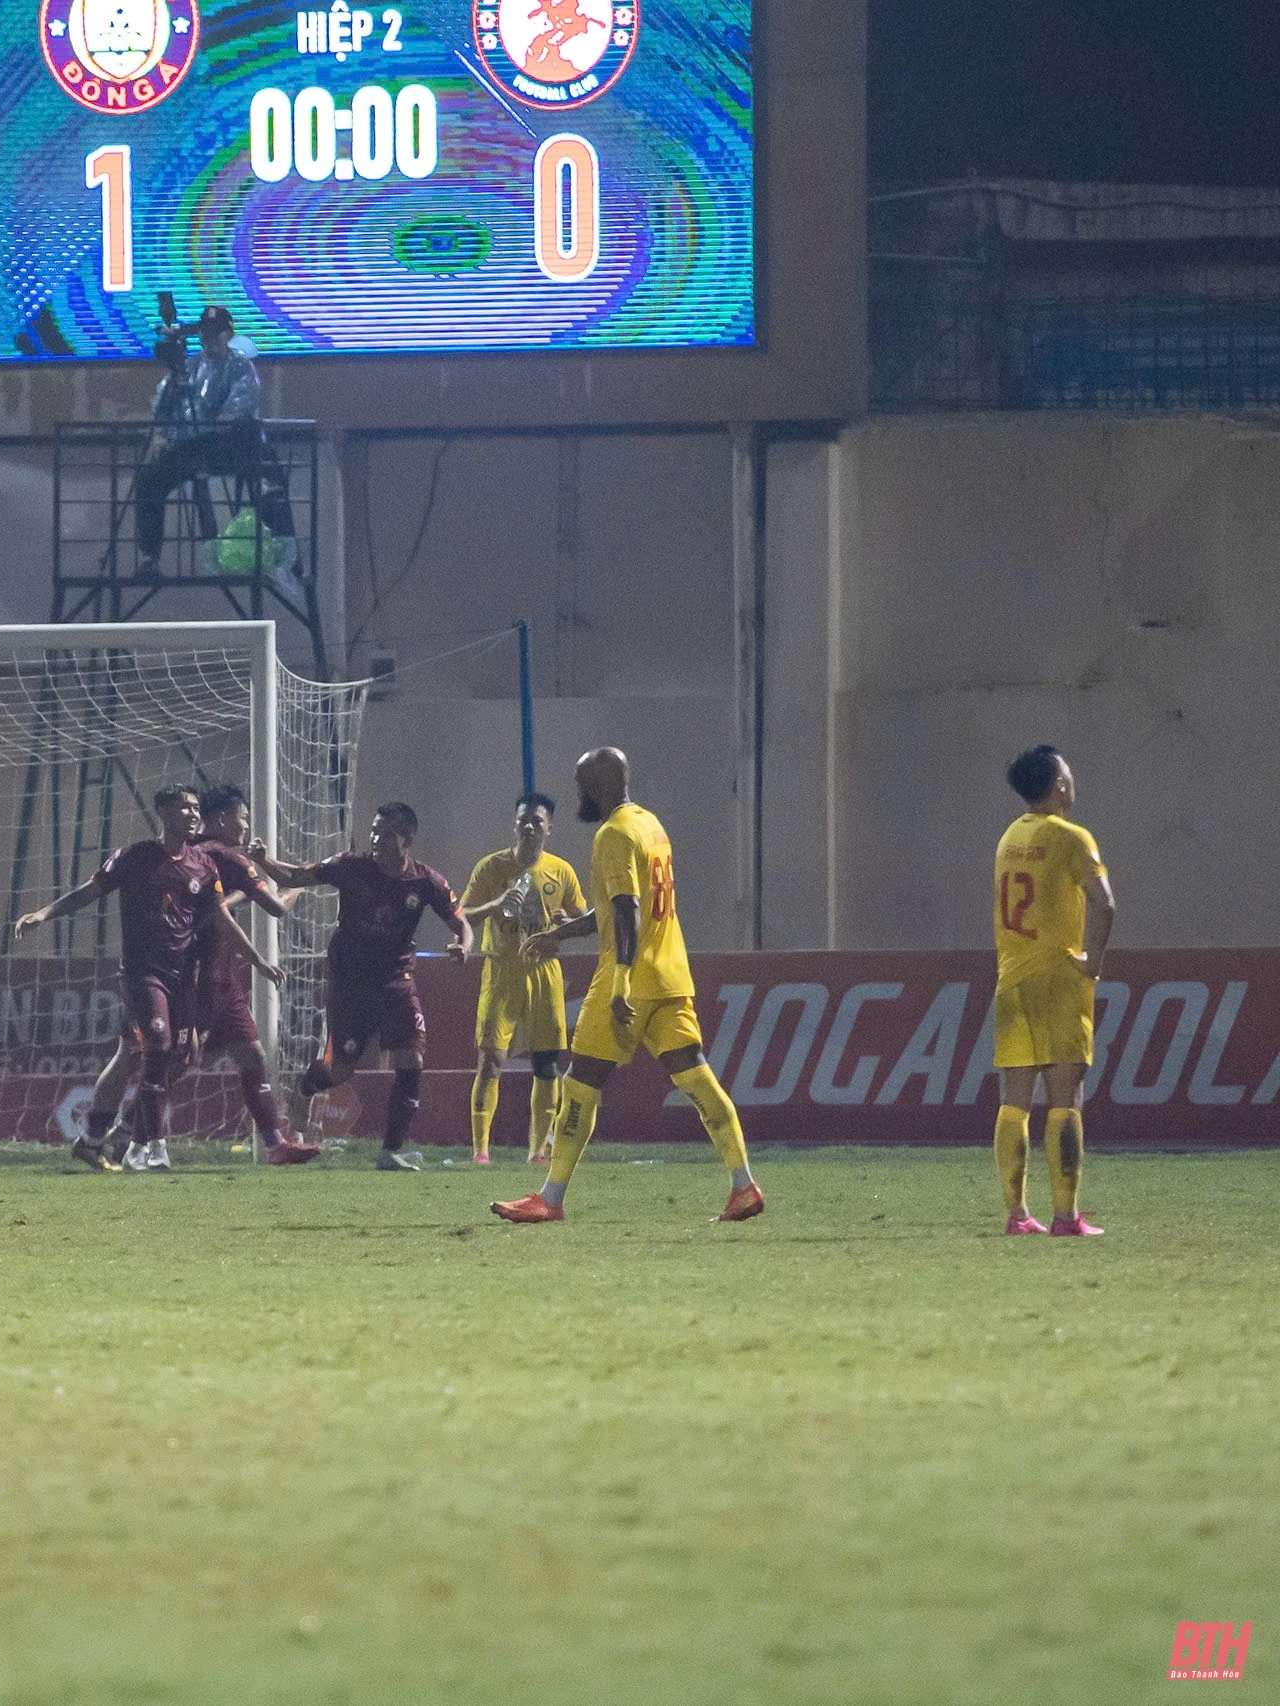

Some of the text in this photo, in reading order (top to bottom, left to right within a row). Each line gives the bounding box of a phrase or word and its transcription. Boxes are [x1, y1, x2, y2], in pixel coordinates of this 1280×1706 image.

[297, 0, 402, 62] HIỆP 2
[250, 84, 438, 182] 00:00
[86, 145, 133, 292] 1
[534, 133, 600, 282] 0
[1001, 871, 1039, 941] 12
